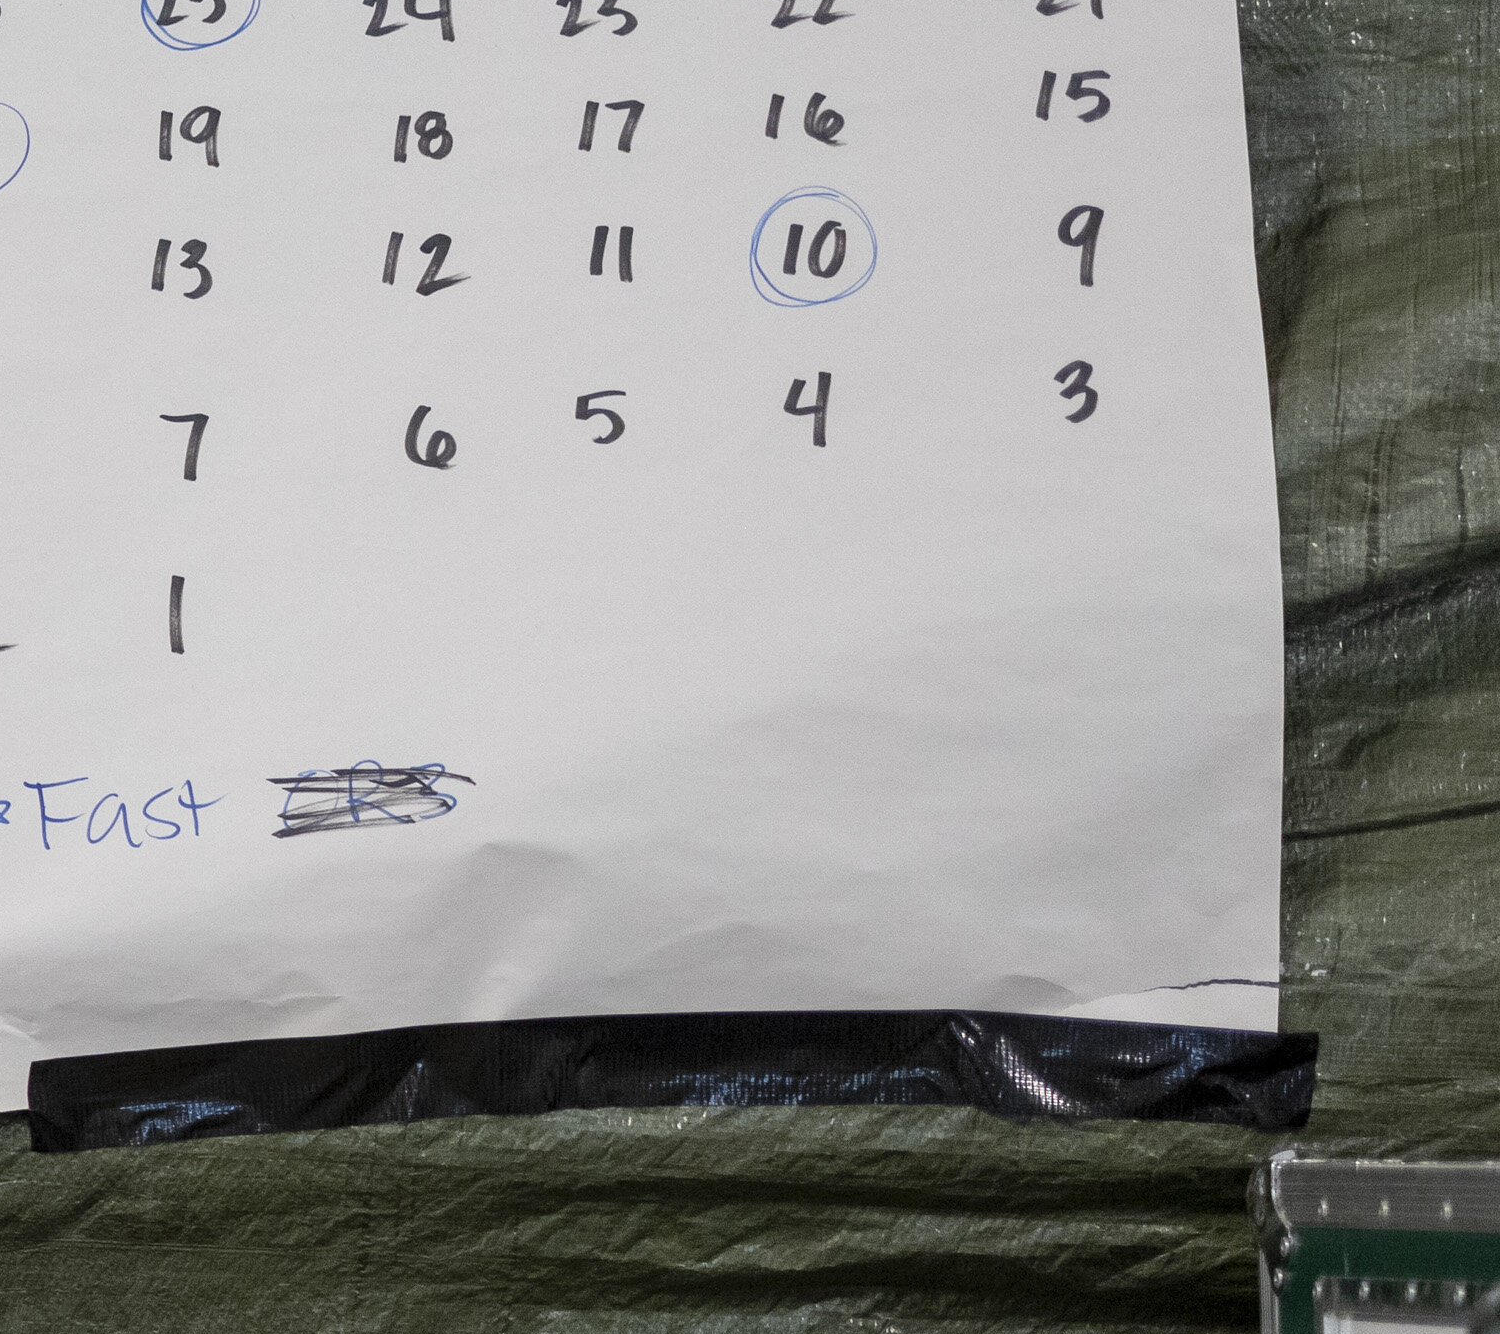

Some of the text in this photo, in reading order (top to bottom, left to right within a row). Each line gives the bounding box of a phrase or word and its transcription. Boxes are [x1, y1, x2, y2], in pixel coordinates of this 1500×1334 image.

[158, 105, 222, 168] 19
[393, 110, 454, 163] 18
[577, 99, 646, 153] 17
[764, 92, 848, 147] 16
[1035, 69, 1111, 124] 15
[151, 237, 214, 300] 13
[381, 231, 473, 297] 12
[588, 224, 635, 283] 11
[782, 219, 848, 279] 10
[1056, 203, 1105, 288] 9
[158, 412, 211, 482] 7
[403, 404, 459, 470] 6
[574, 389, 627, 445] 5
[782, 370, 833, 449] 4
[1052, 358, 1099, 424] 3
[168, 574, 186, 655] 1
[23, 776, 228, 850] Fast
